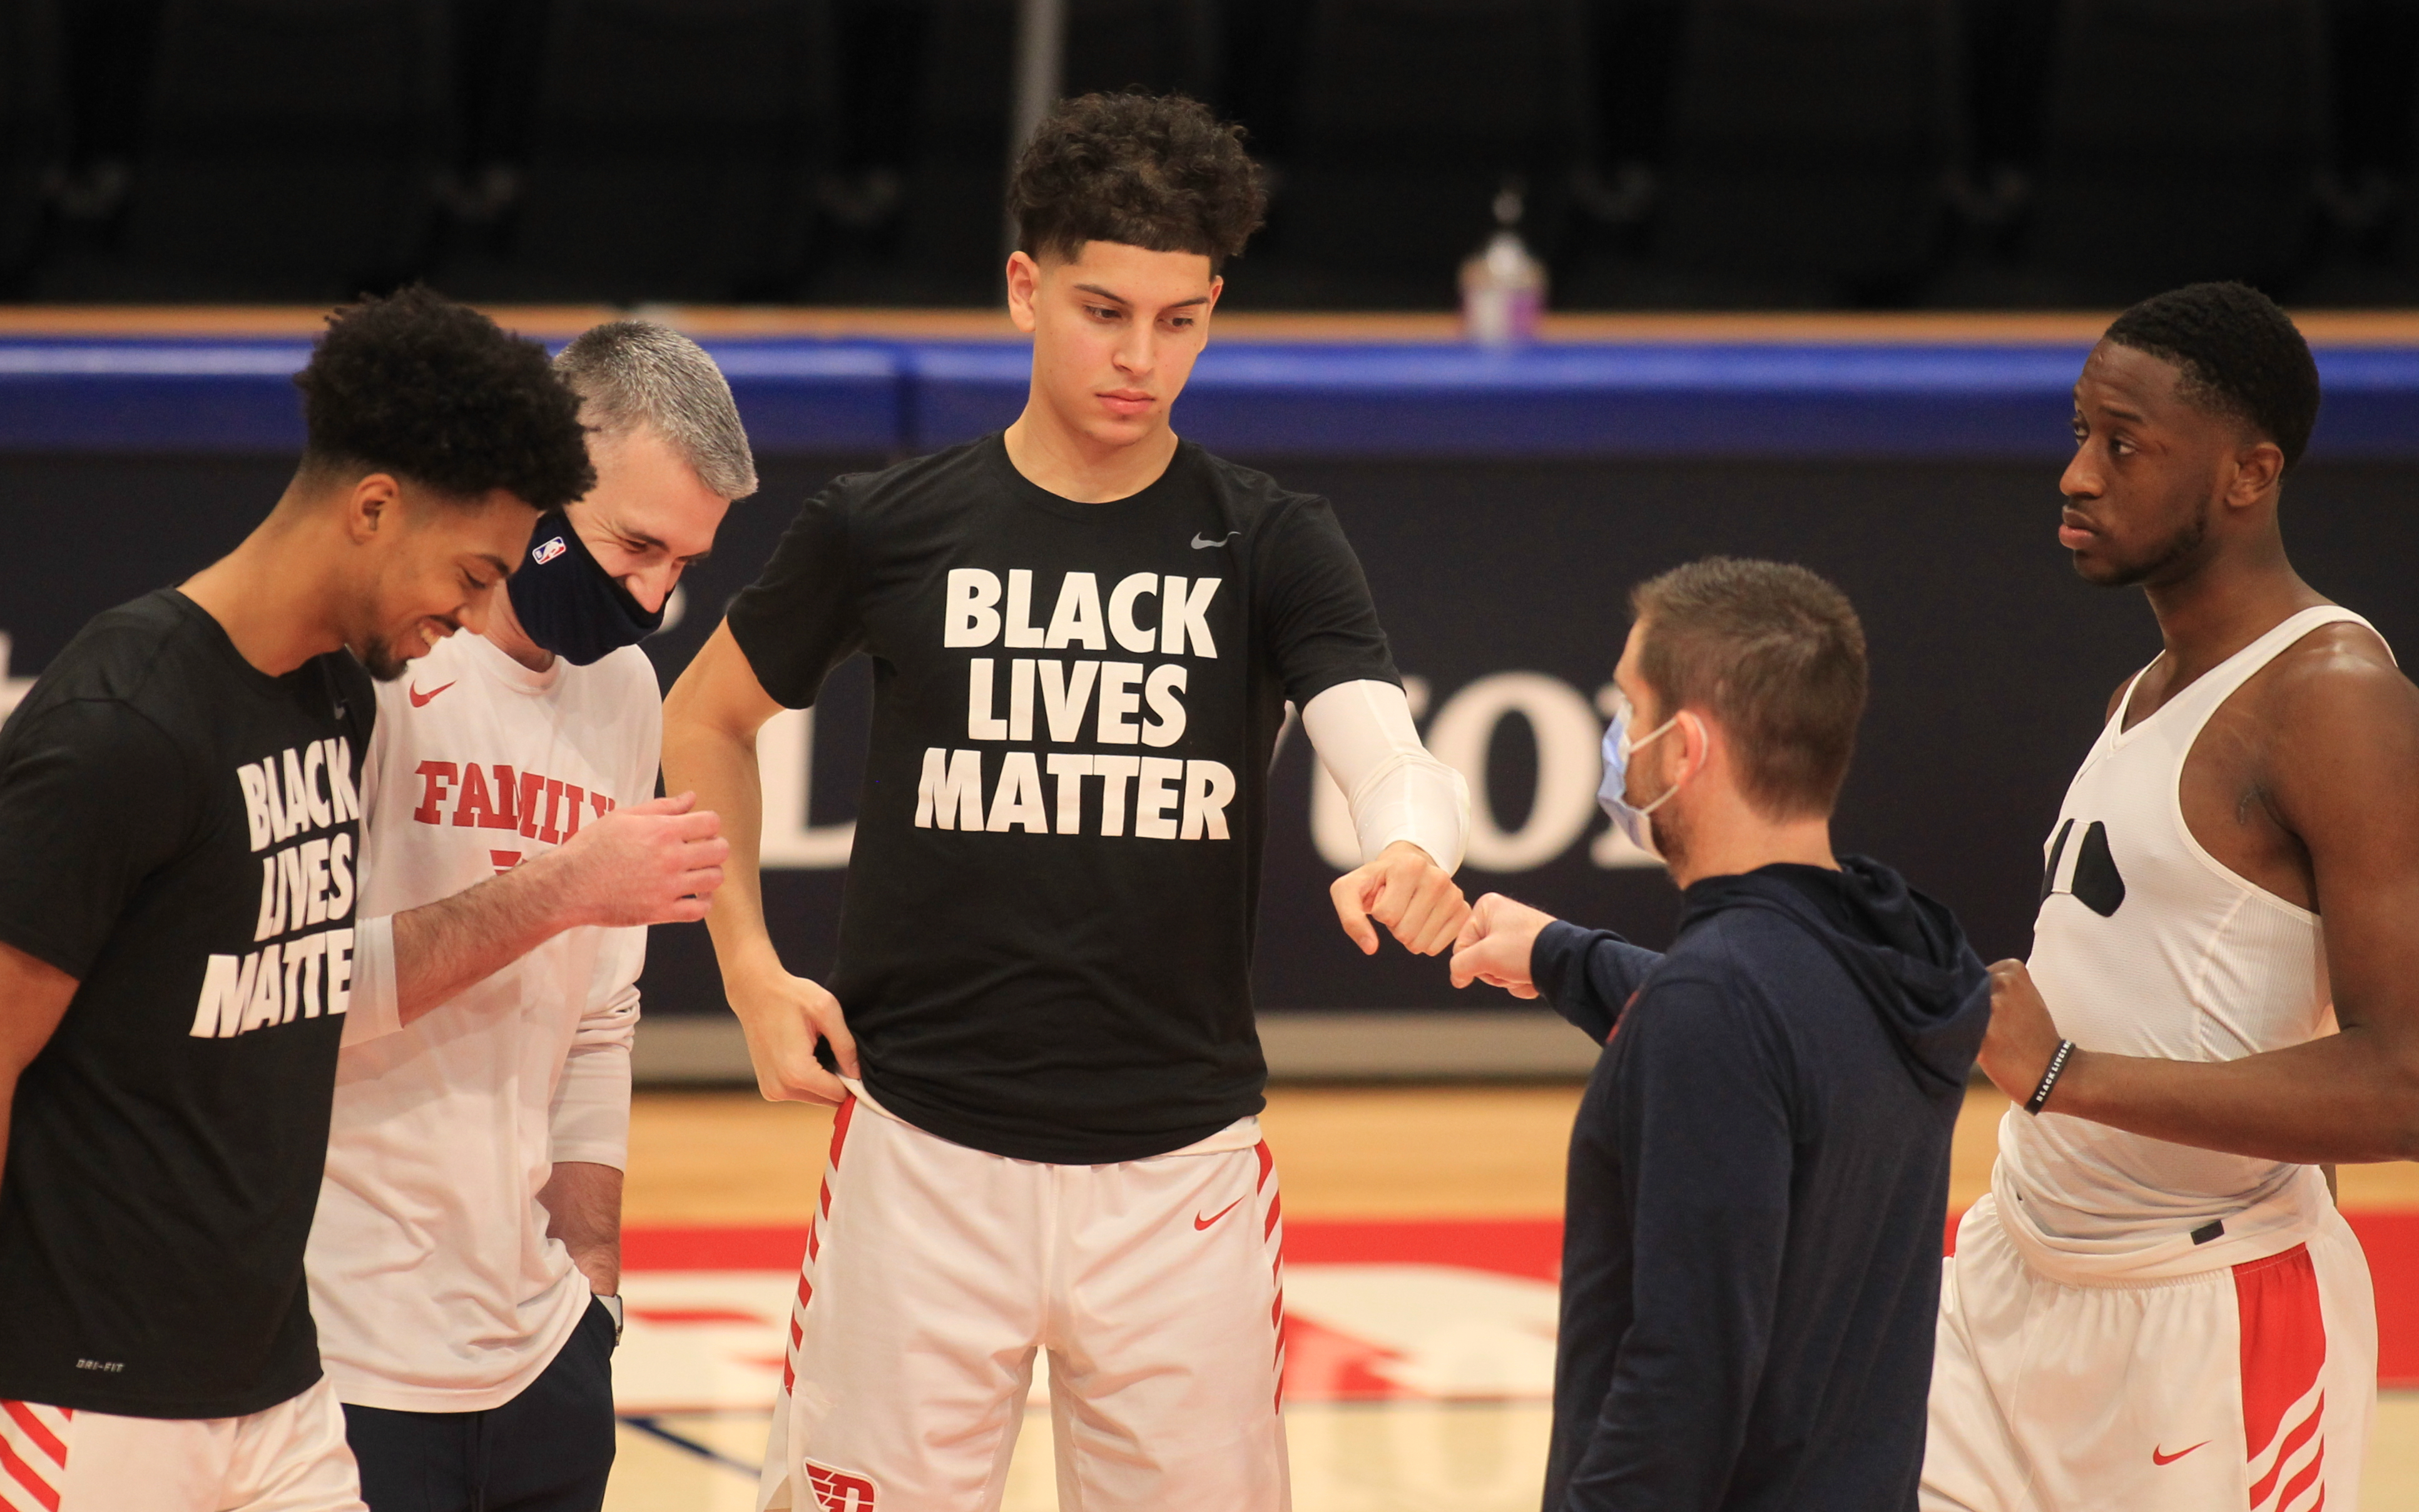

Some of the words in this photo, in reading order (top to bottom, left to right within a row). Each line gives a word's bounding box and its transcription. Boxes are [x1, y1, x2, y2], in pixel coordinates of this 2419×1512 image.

[944, 568, 1222, 659] BLACK
[968, 658, 1188, 748] LIVES
[237, 736, 359, 852] BLACK
[915, 747, 1236, 840] MATTER
[253, 832, 354, 942] LIVES
[189, 928, 354, 1038] MATTE
[2036, 1072, 2055, 1102] BLACK
[2052, 1048, 2067, 1072] LIVES
[76, 1359, 125, 1372] DRI-FIT
